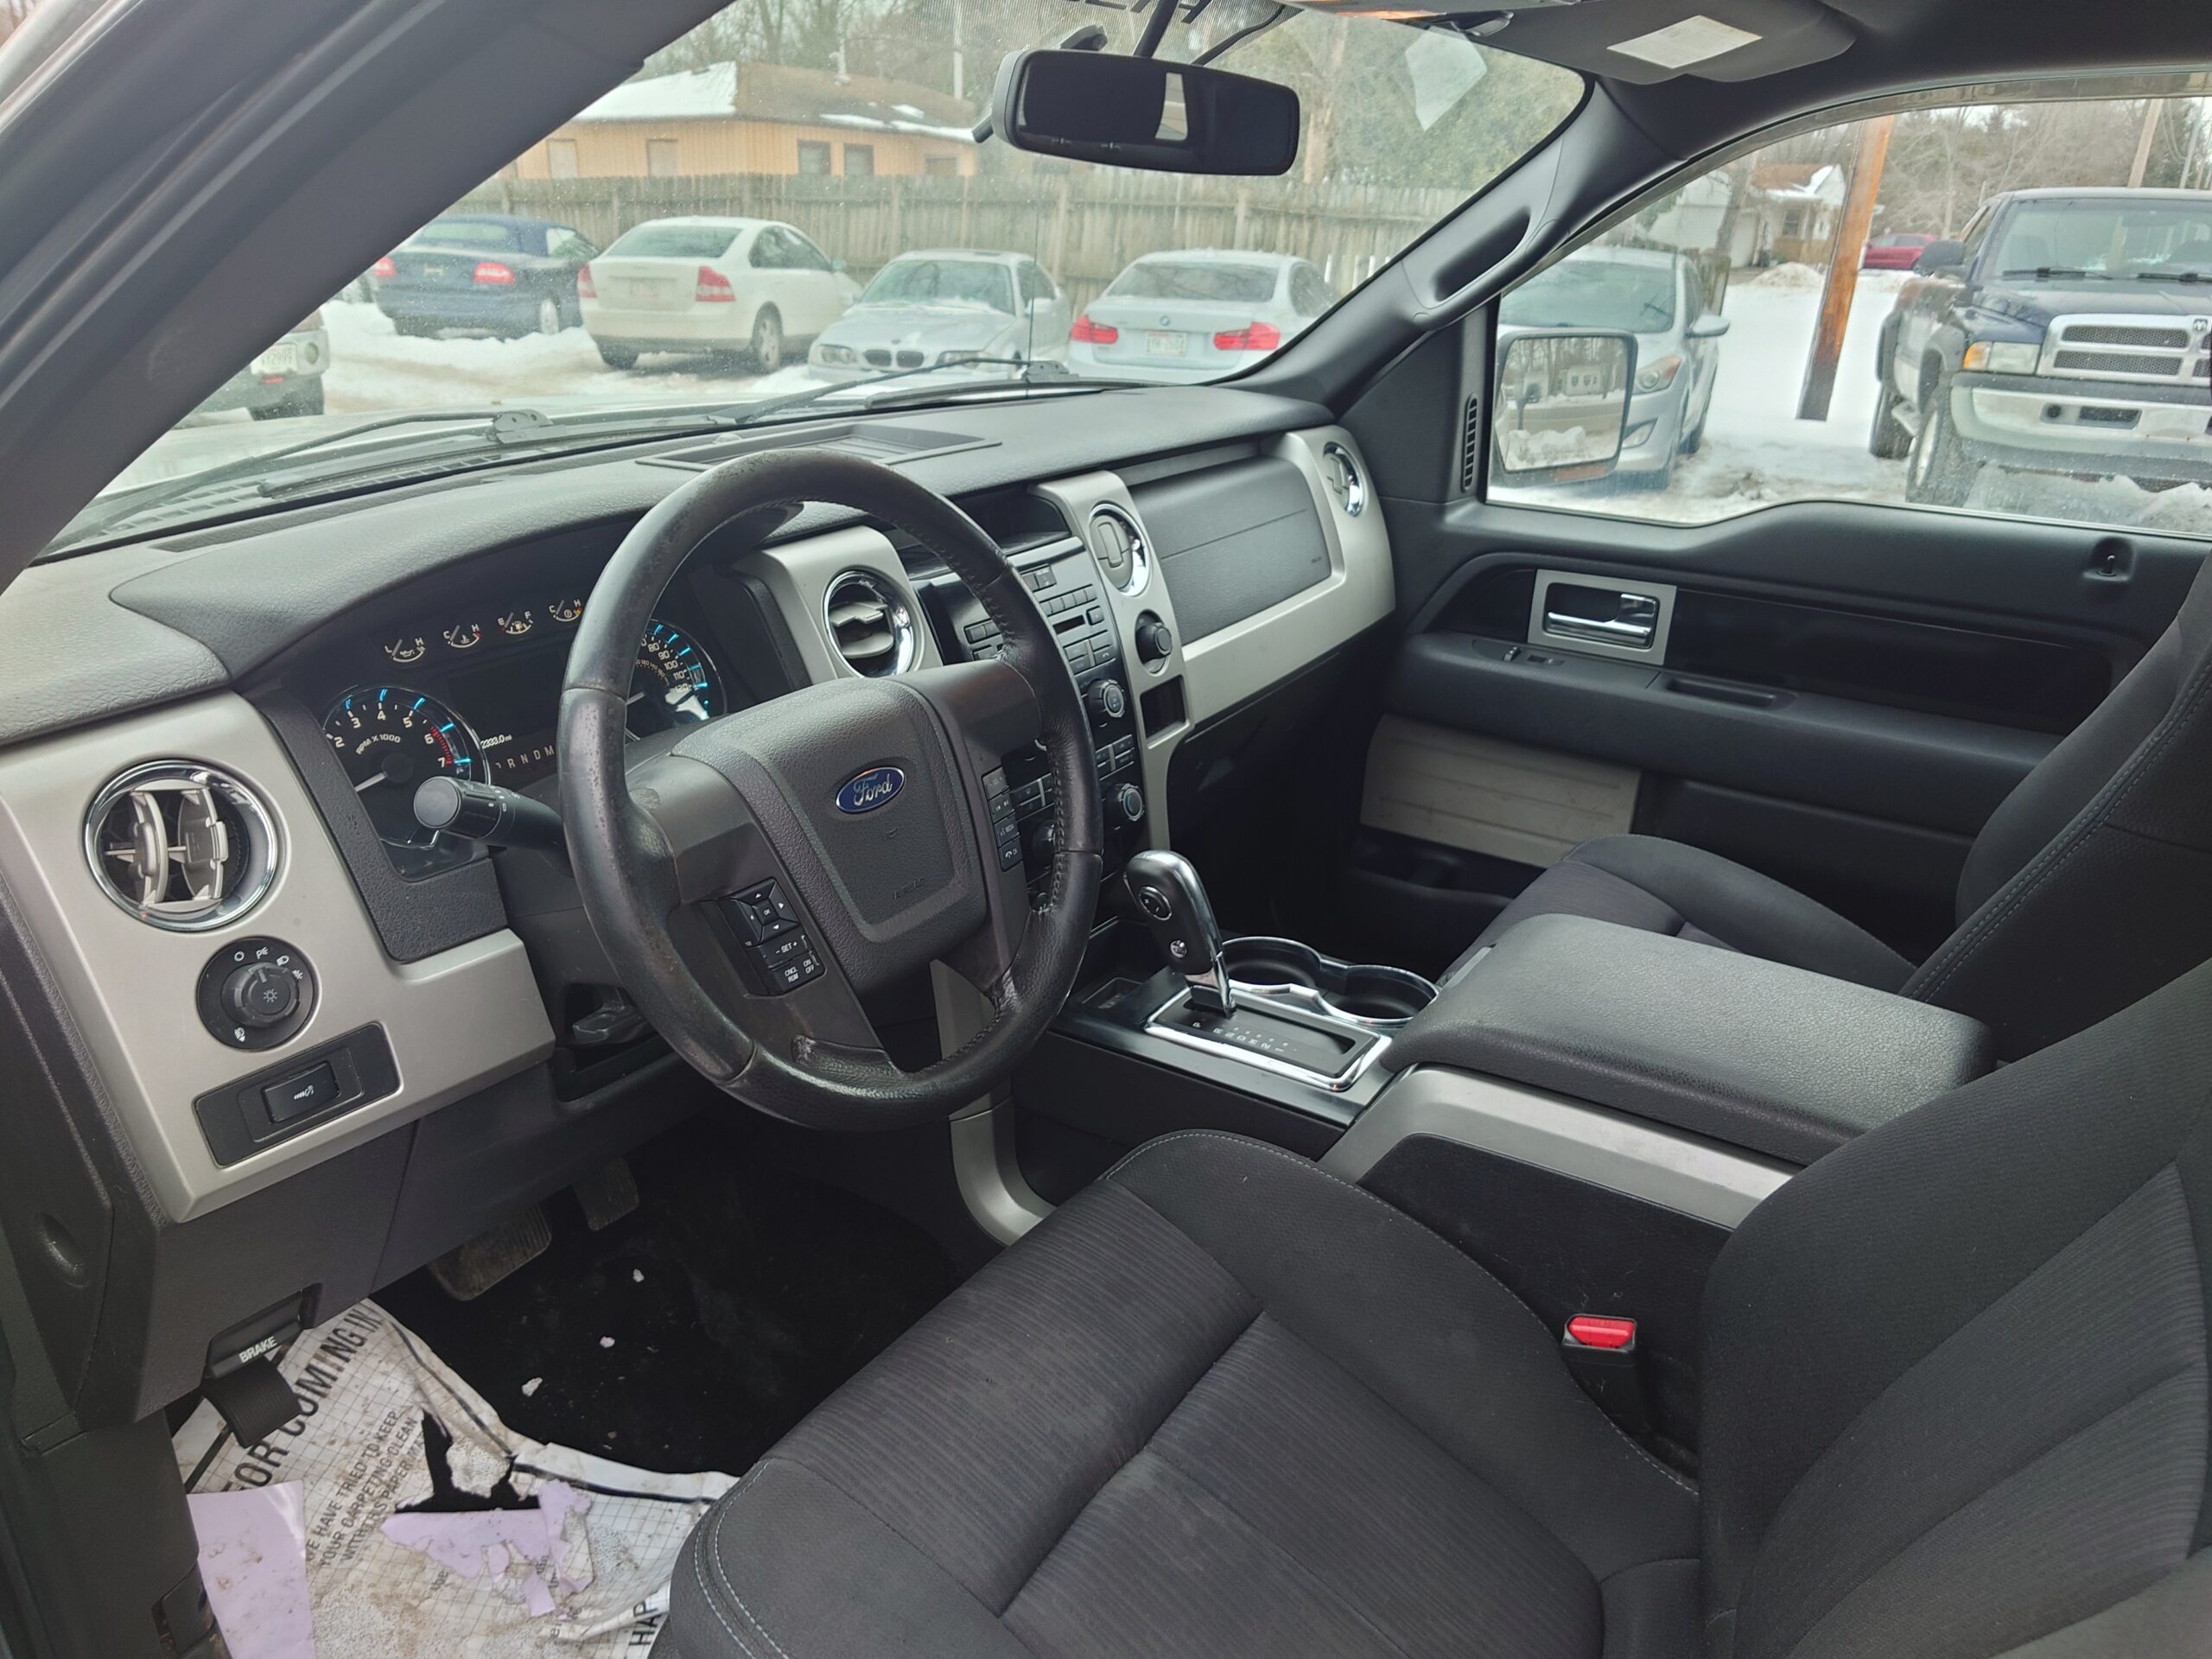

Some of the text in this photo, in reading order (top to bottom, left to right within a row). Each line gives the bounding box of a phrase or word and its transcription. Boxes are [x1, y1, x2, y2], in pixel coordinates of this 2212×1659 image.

[524, 611, 531, 620] F
[471, 623, 480, 632] H
[443, 631, 450, 639] C
[415, 638, 424, 646] H
[648, 642, 660, 652] 80
[658, 650, 670, 660] 90
[664, 660, 678, 671] 100
[673, 671, 685, 680] 110
[676, 683, 689, 692] 120
[377, 710, 386, 721] 4
[352, 717, 361, 728] 3
[403, 716, 413, 728] 5
[334, 736, 345, 748] 2
[355, 739, 372, 755] RPM
[379, 734, 401, 744] 1000
[424, 733, 434, 745] 6
[437, 757, 446, 767] 7
[507, 758, 516, 769] R
[520, 753, 529, 764] N
[533, 749, 541, 760] D
[543, 745, 555, 756] M
[853, 773, 893, 806] Ford
[781, 942, 792, 953] SET
[239, 1336, 277, 1363] BRAKE
[316, 1500, 342, 1537] HAVE
[336, 1461, 367, 1498] TRIED
[361, 1443, 380, 1459] TO
[375, 1409, 398, 1442] KEEP
[381, 1458, 413, 1501] PAPER
[317, 1417, 418, 1569] YOUR CARPETING CLEAN
